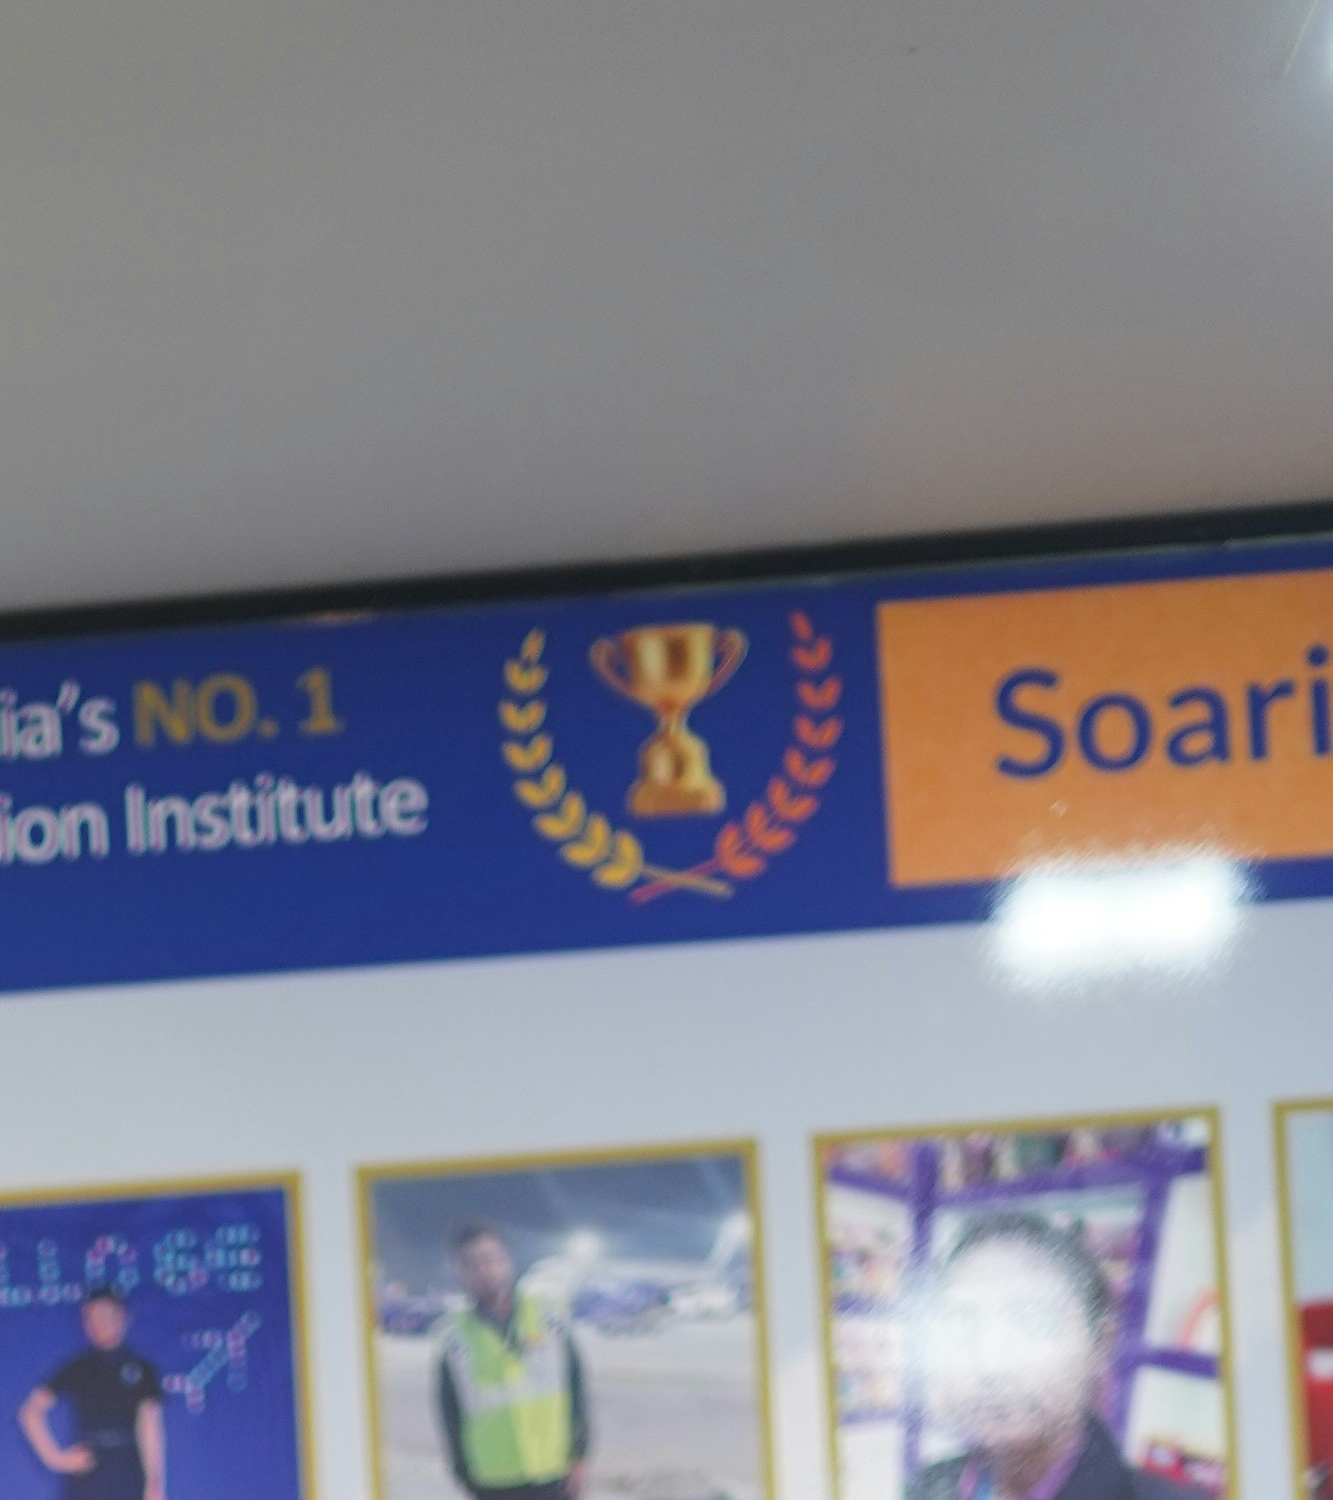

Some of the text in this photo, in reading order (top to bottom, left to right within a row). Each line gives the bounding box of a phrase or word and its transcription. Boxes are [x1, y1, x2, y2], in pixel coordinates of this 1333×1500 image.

[135, 672, 280, 747] NO.
[298, 666, 344, 736] 1
[993, 643, 1333, 780] Soari
[125, 770, 430, 855] Institute
